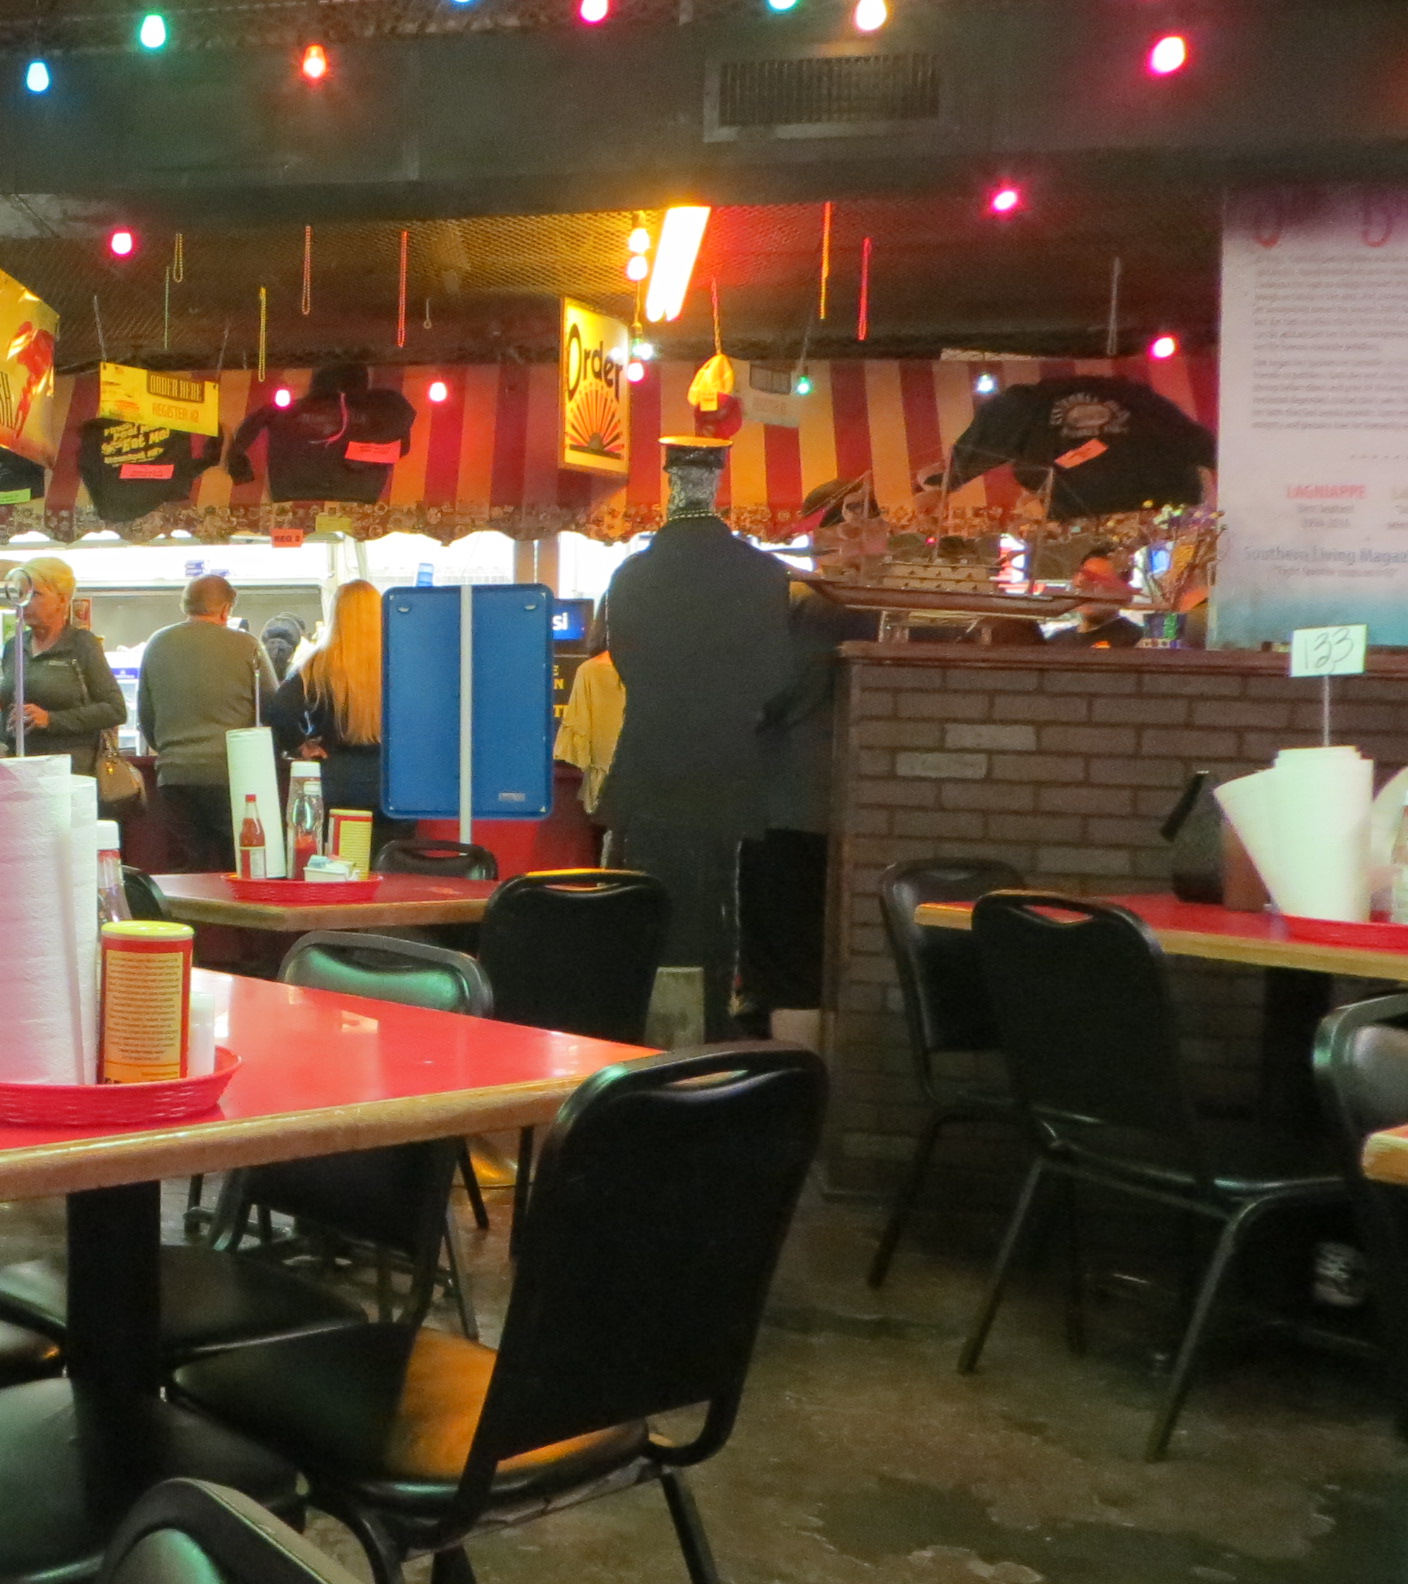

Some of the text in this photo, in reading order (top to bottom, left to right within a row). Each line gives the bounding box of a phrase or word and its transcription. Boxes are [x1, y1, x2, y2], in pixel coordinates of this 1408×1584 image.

[566, 322, 625, 404] Order
[150, 375, 202, 401] ORDER HERE
[152, 402, 188, 420] REGISTER
